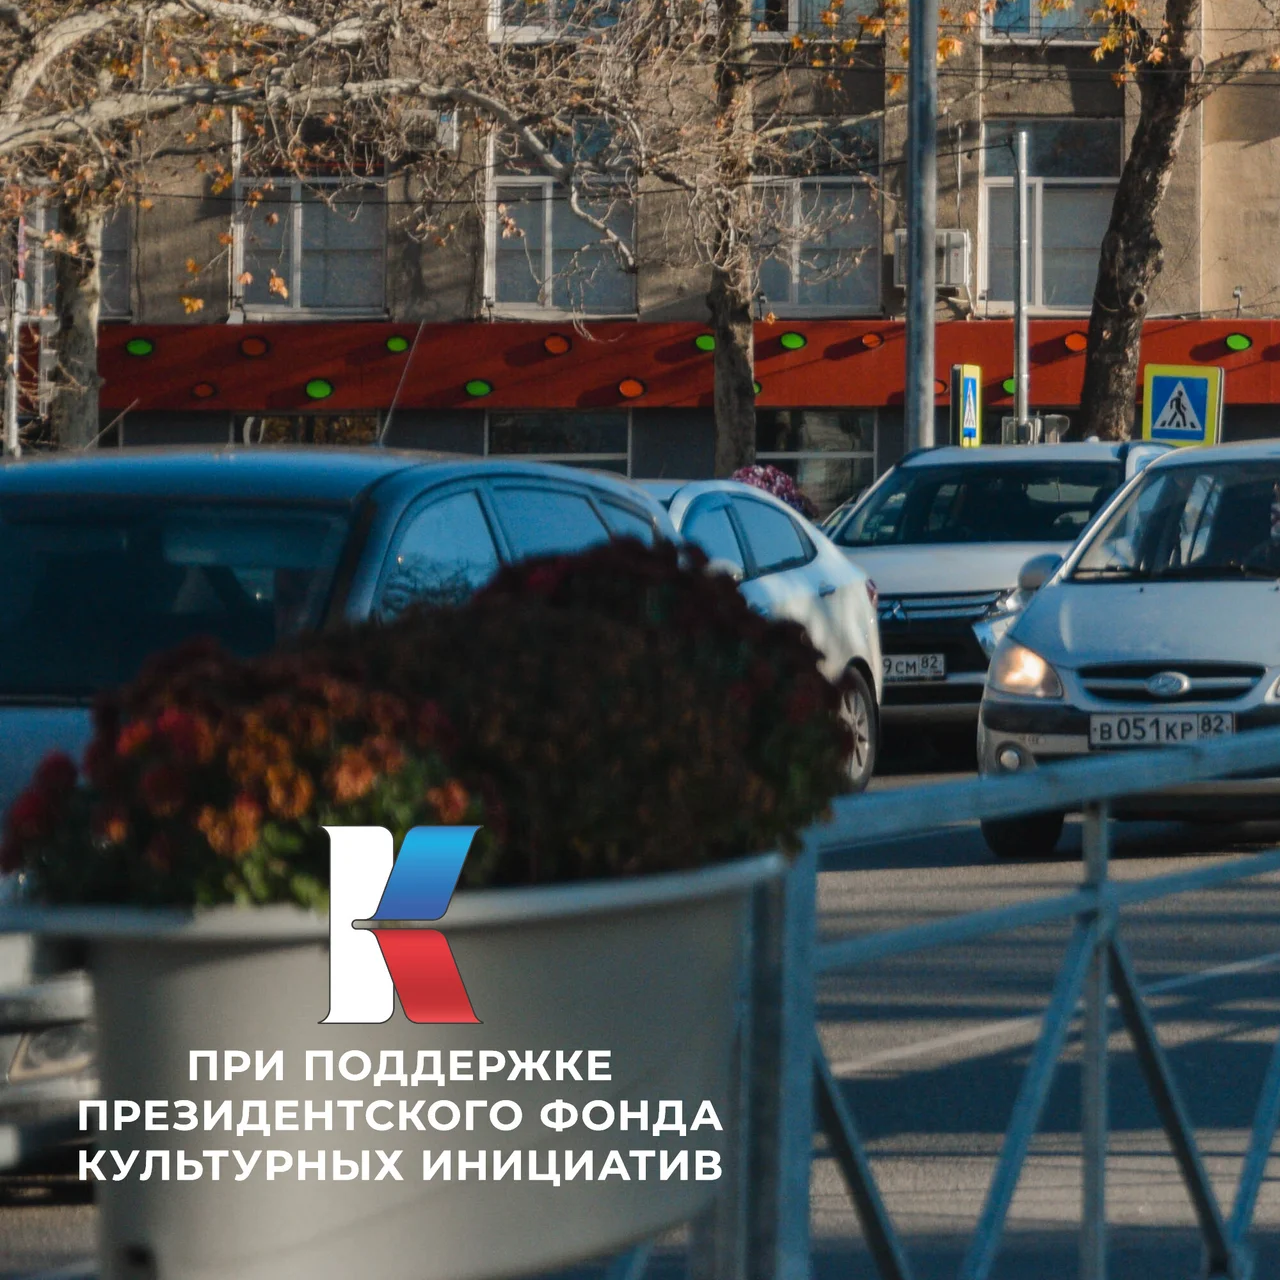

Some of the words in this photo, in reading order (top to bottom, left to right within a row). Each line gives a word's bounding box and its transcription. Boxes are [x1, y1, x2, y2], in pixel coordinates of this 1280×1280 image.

[920, 655, 939, 669] 82
[1099, 717, 1194, 742] В051КР
[1201, 715, 1225, 733] 82
